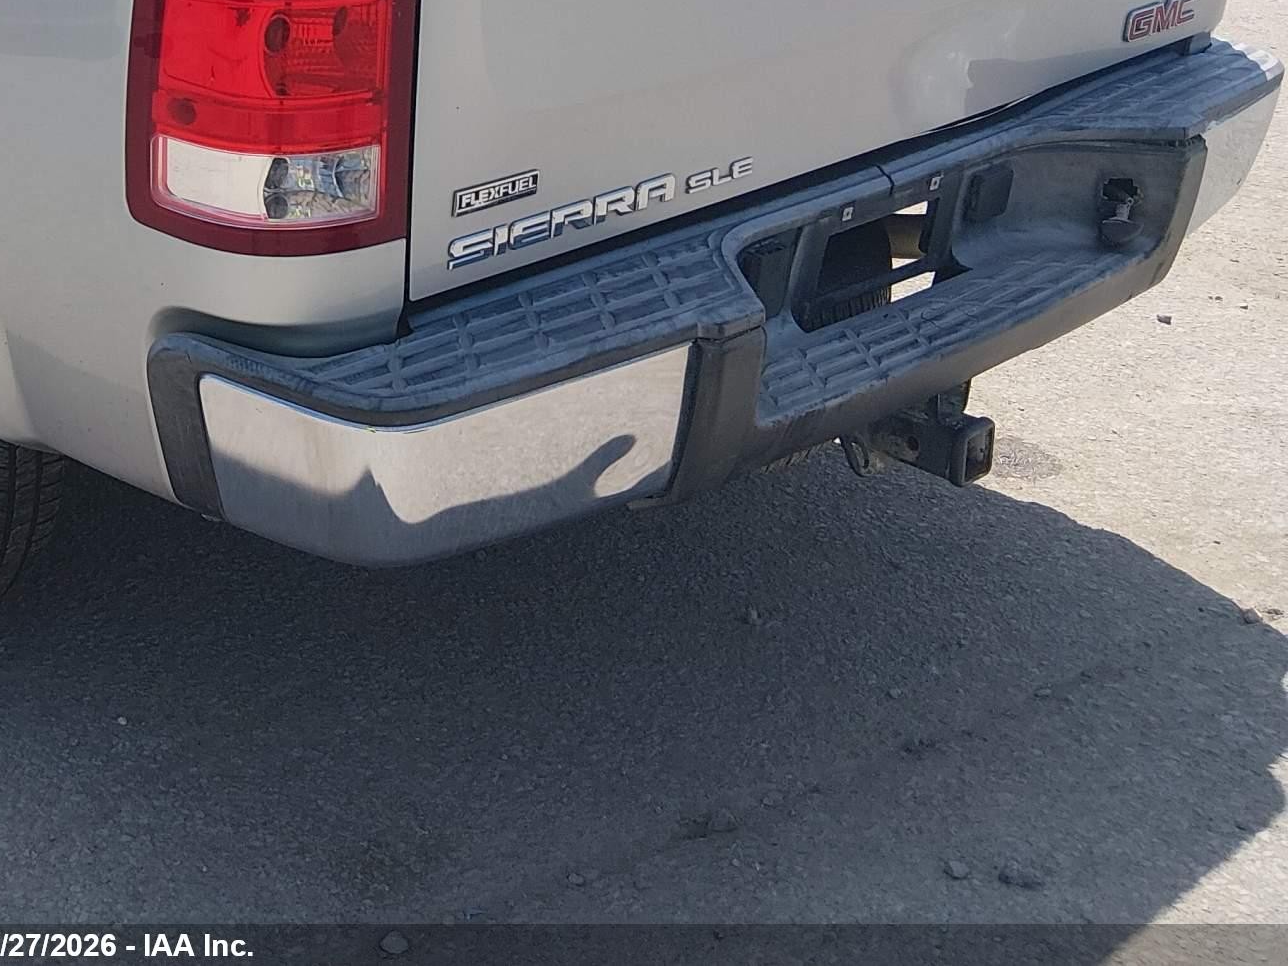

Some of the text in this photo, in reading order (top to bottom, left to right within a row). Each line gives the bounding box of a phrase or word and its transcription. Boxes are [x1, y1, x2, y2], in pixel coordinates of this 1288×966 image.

[447, 156, 754, 270] SIERRA SLE
[460, 173, 538, 209] FLEXFUEL
